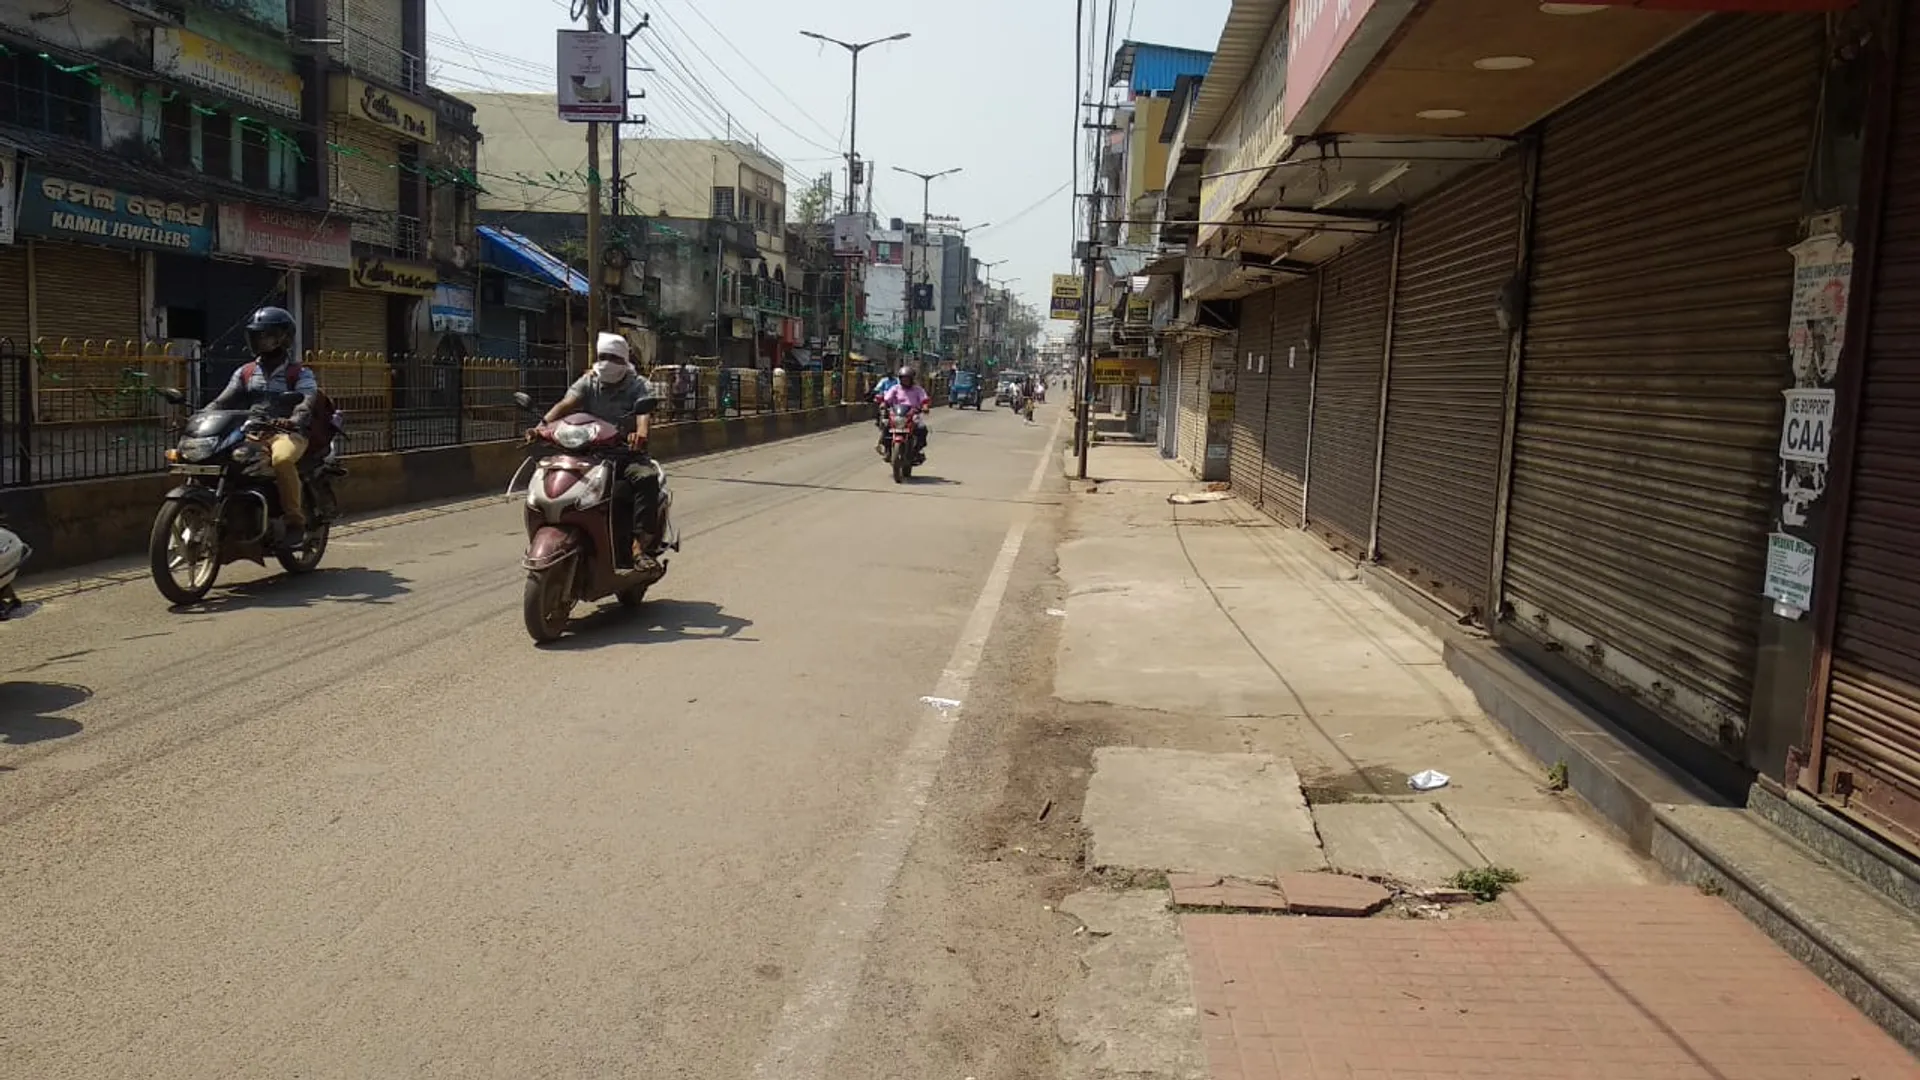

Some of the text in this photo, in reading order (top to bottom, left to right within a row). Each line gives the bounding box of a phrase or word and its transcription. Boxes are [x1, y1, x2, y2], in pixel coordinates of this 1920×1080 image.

[52, 210, 191, 248] KAMAL JEWELLERS
[1801, 397, 1830, 416] SUPPORT
[1787, 418, 1824, 453] CAA
